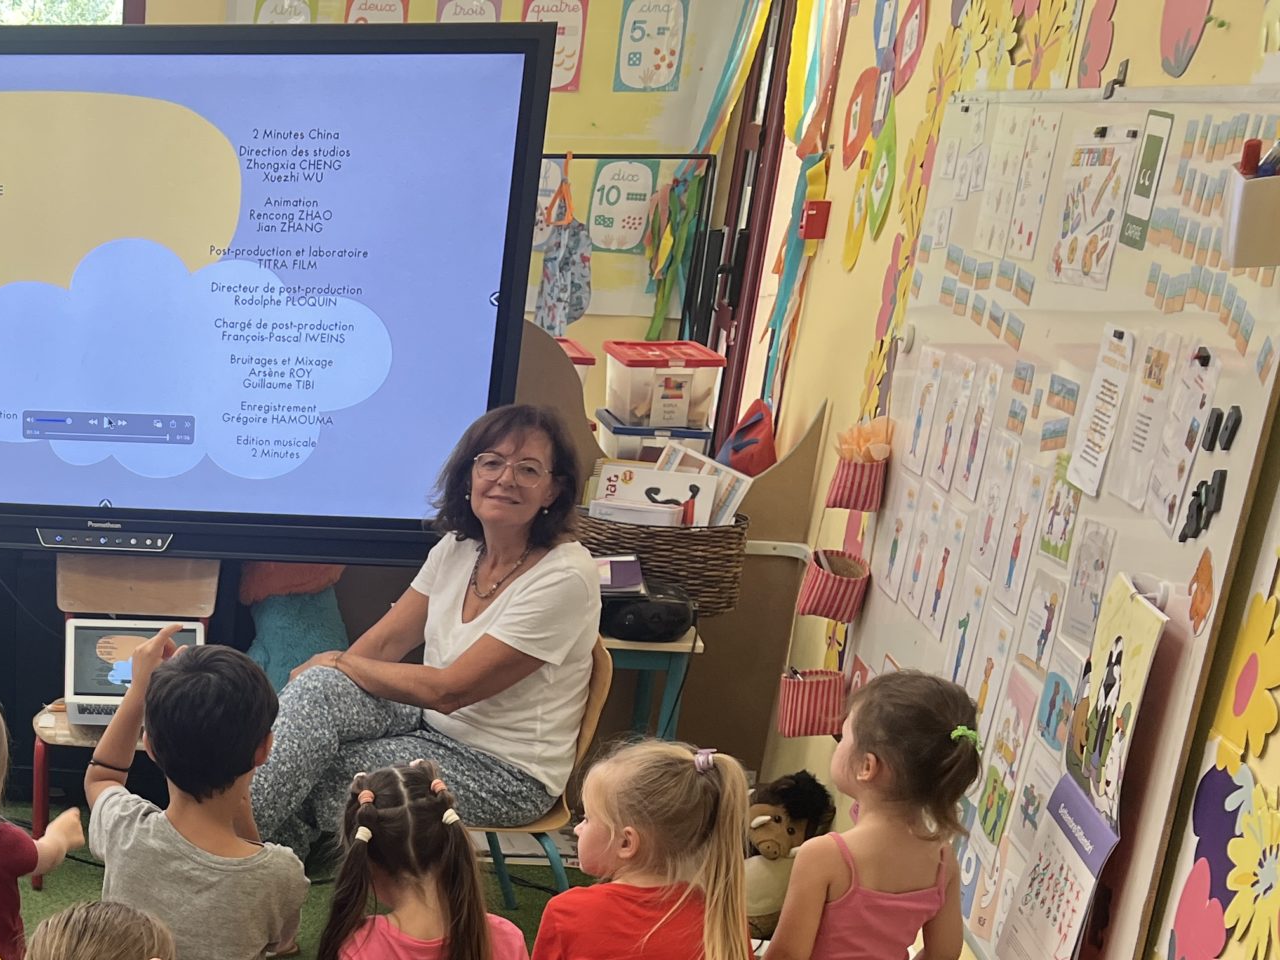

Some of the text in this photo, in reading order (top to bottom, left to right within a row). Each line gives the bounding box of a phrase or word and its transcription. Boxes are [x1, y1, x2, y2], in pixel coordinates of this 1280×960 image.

[358, 0, 397, 13] deux
[452, 1, 486, 17] trois
[531, 1, 581, 22] quatre
[639, 3, 673, 25] cinq
[629, 20, 647, 43] 5
[253, 129, 339, 140] 2 Minutes China
[239, 145, 350, 157] Direction des studios
[246, 158, 341, 172] Zhongxia CHENG
[263, 171, 323, 183] Xuezhi WU
[610, 169, 640, 182] dix
[597, 185, 621, 206] 10
[264, 197, 318, 208] Animation
[298, 210, 332, 221] ZHAO
[257, 221, 323, 233] Jian ZHANG
[210, 245, 368, 259] Post-production et laboratoire
[257, 259, 317, 270] TITRA FILM
[211, 282, 362, 296] Directeur de post-production
[235, 295, 281, 308] Rodolphe
[215, 318, 354, 333] Chargé de post-production
[222, 330, 302, 343] François-Pascal
[231, 354, 333, 369] Bruitages et Mixage
[248, 367, 312, 378] Arsène ROY
[243, 378, 314, 390] Guillaume TIBI
[240, 401, 316, 415] Enregistrement
[222, 413, 333, 425] Grégoire HAMOUMA
[237, 435, 316, 447] Edition musicale
[252, 448, 299, 459] 2 Minutes
[87, 520, 122, 529] Promethean
